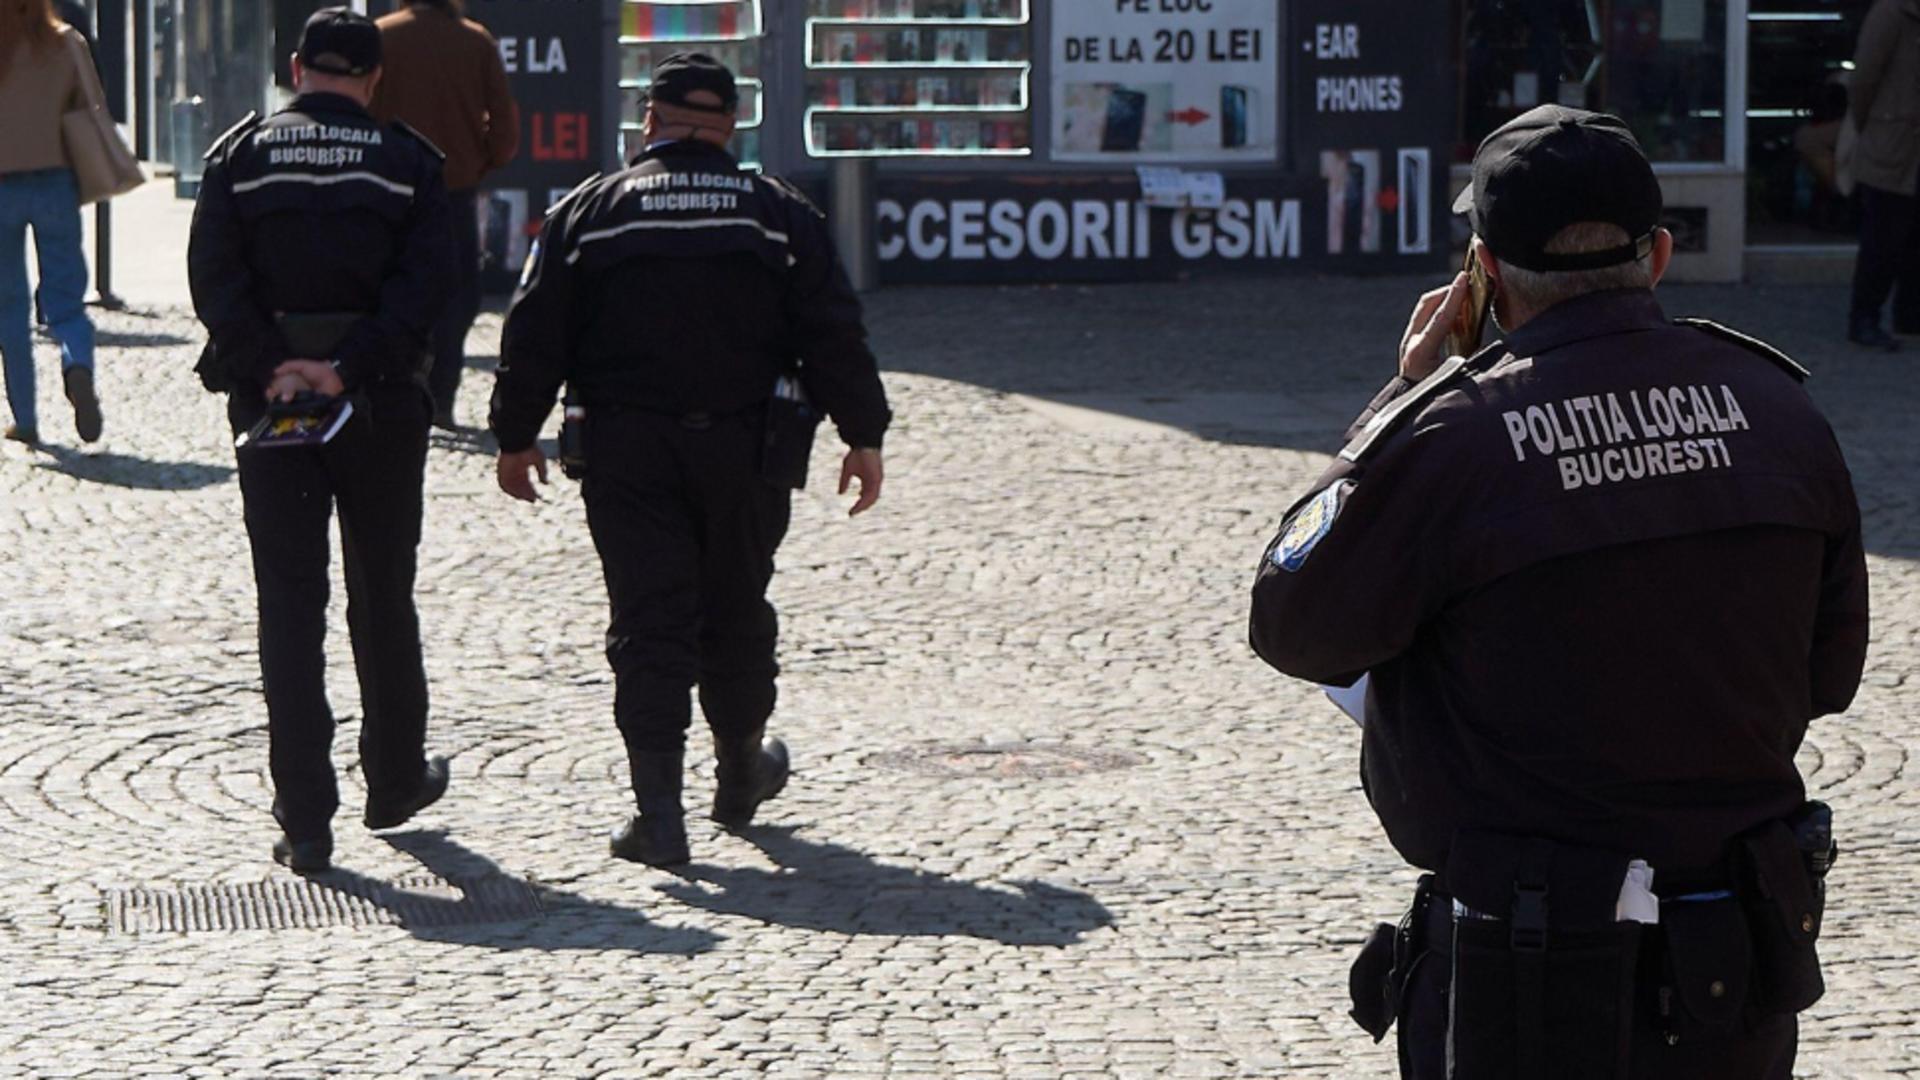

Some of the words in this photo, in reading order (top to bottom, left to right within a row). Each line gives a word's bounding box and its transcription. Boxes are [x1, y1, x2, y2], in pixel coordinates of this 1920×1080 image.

[526, 37, 568, 73] LA
[1065, 37, 1099, 62] DE
[1109, 38, 1144, 62] LA
[1153, 29, 1195, 63] 20
[1207, 29, 1262, 63] LEI
[1316, 77, 1402, 112] PHONES
[531, 112, 588, 161] LEI
[877, 199, 1150, 260] CCESORII
[1170, 199, 1300, 260] GSM
[1502, 391, 1636, 462] POLITIA
[1630, 384, 1750, 439] LOCALA
[1557, 437, 1732, 490] BUCURESTI
